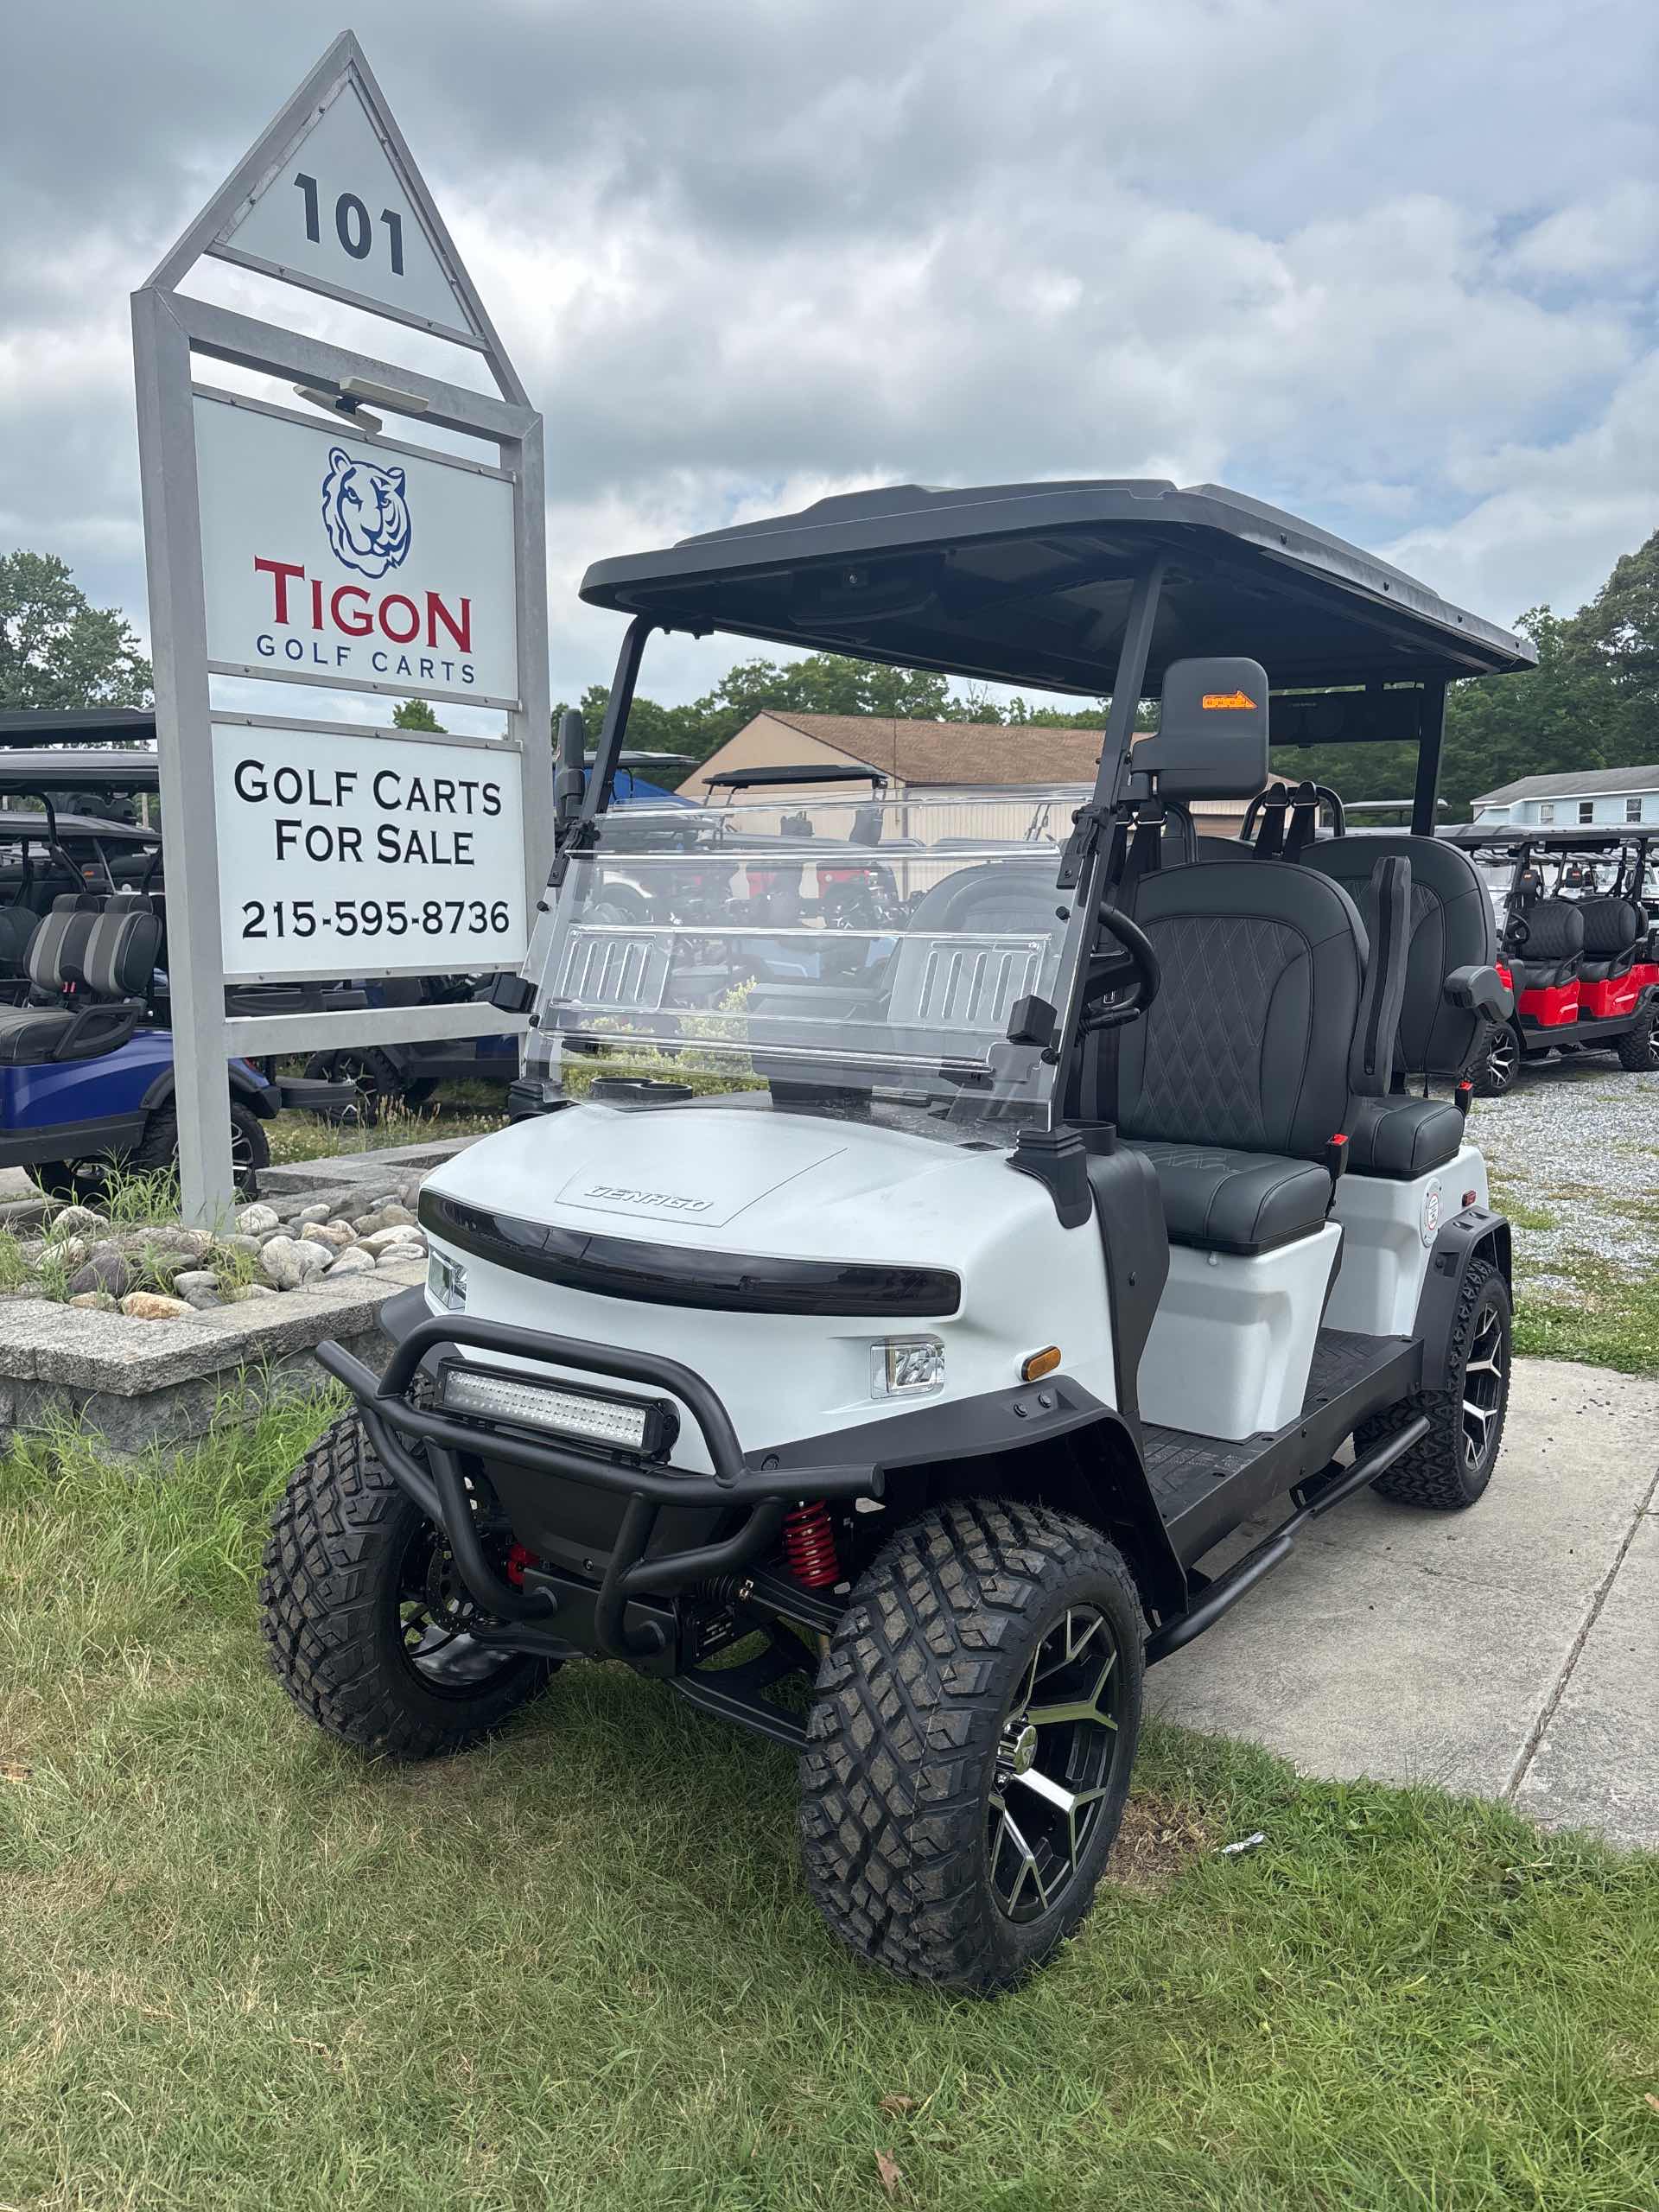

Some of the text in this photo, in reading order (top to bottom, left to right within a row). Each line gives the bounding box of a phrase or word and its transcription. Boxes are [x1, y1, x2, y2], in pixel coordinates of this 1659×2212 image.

[294, 172, 404, 276] 101
[254, 554, 473, 654] TIGON
[256, 633, 475, 684] GOLF CARTS
[233, 759, 502, 817] GOLF CARTS
[274, 818, 475, 867] FOR SALE
[241, 899, 510, 939] 215-595-8736
[585, 1185, 714, 1211] DENAGO
